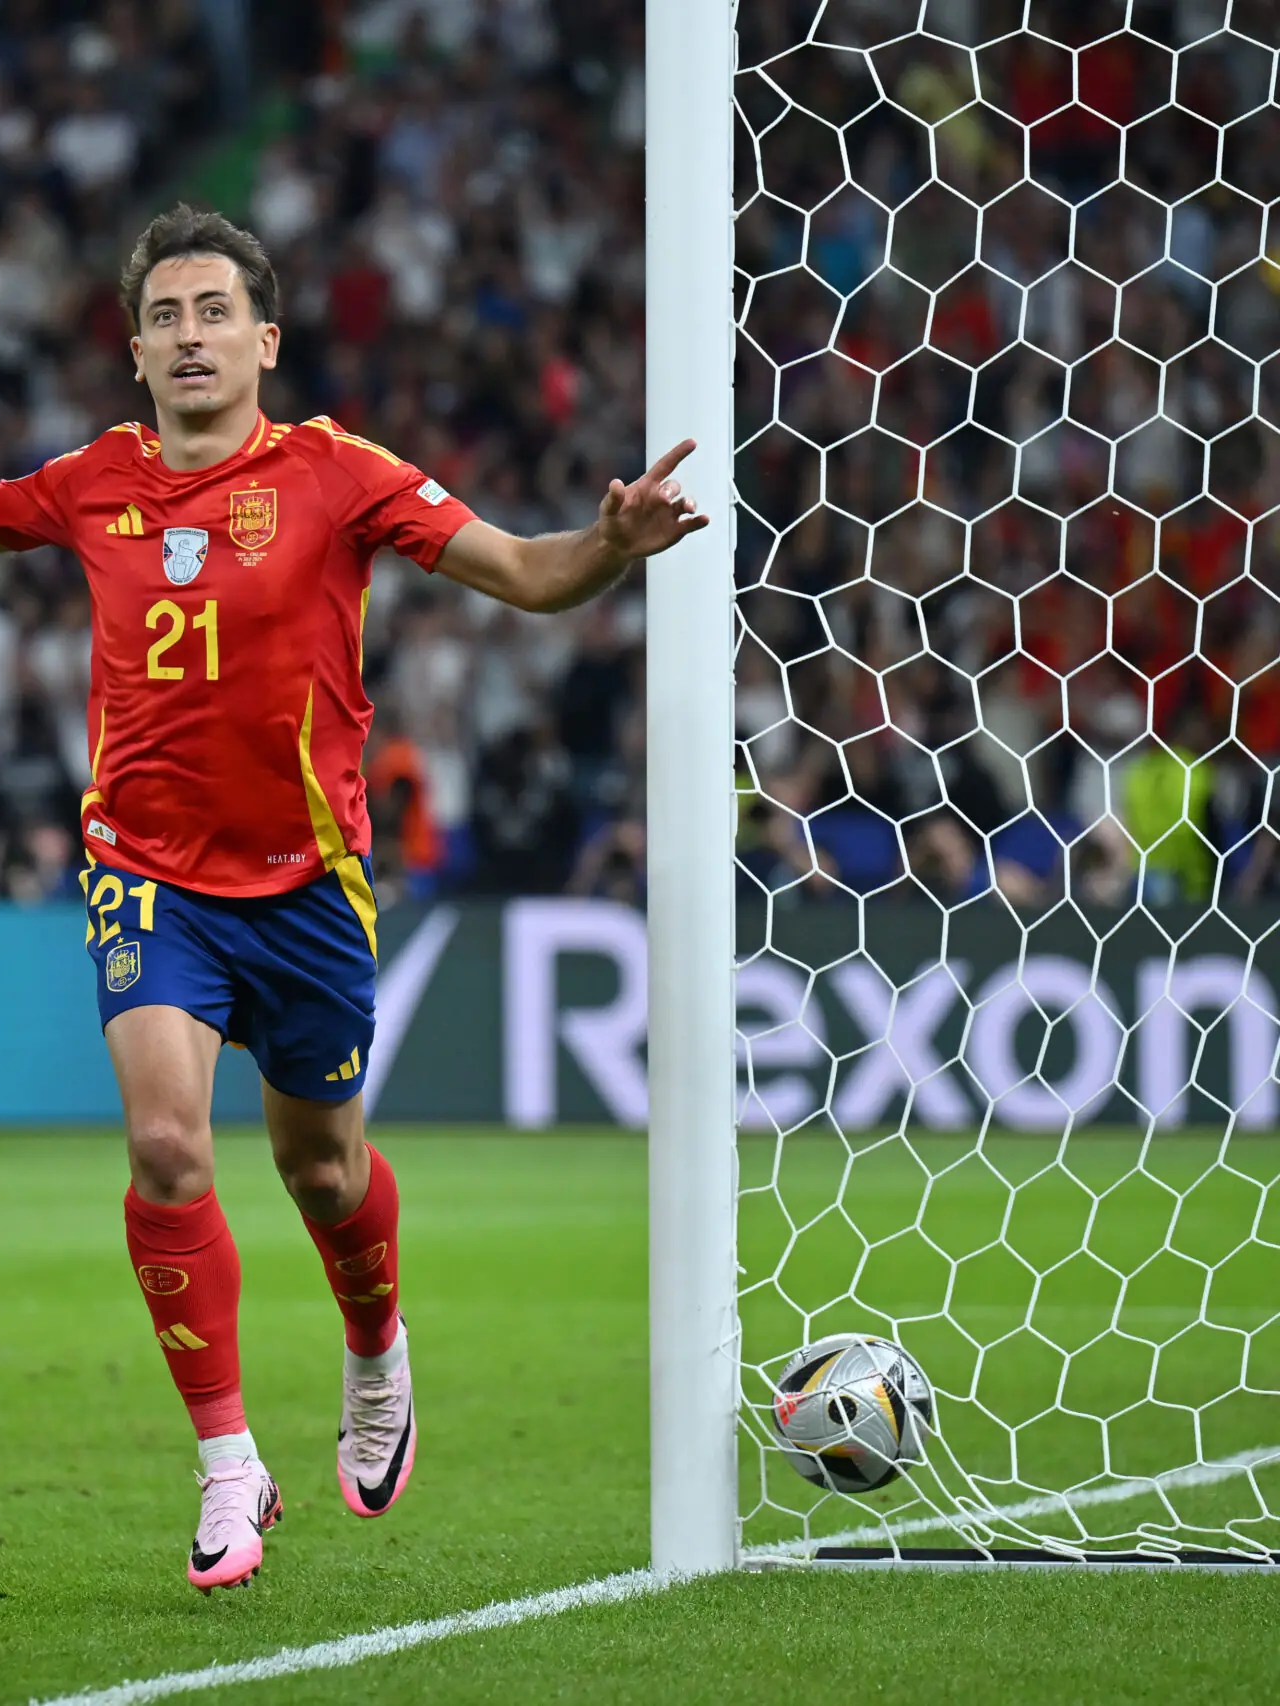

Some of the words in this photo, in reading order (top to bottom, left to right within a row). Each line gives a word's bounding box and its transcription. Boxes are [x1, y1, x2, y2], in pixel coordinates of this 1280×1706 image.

[145, 599, 219, 681] 21
[267, 853, 306, 864] HEAT.RDY
[90, 874, 158, 948] 21
